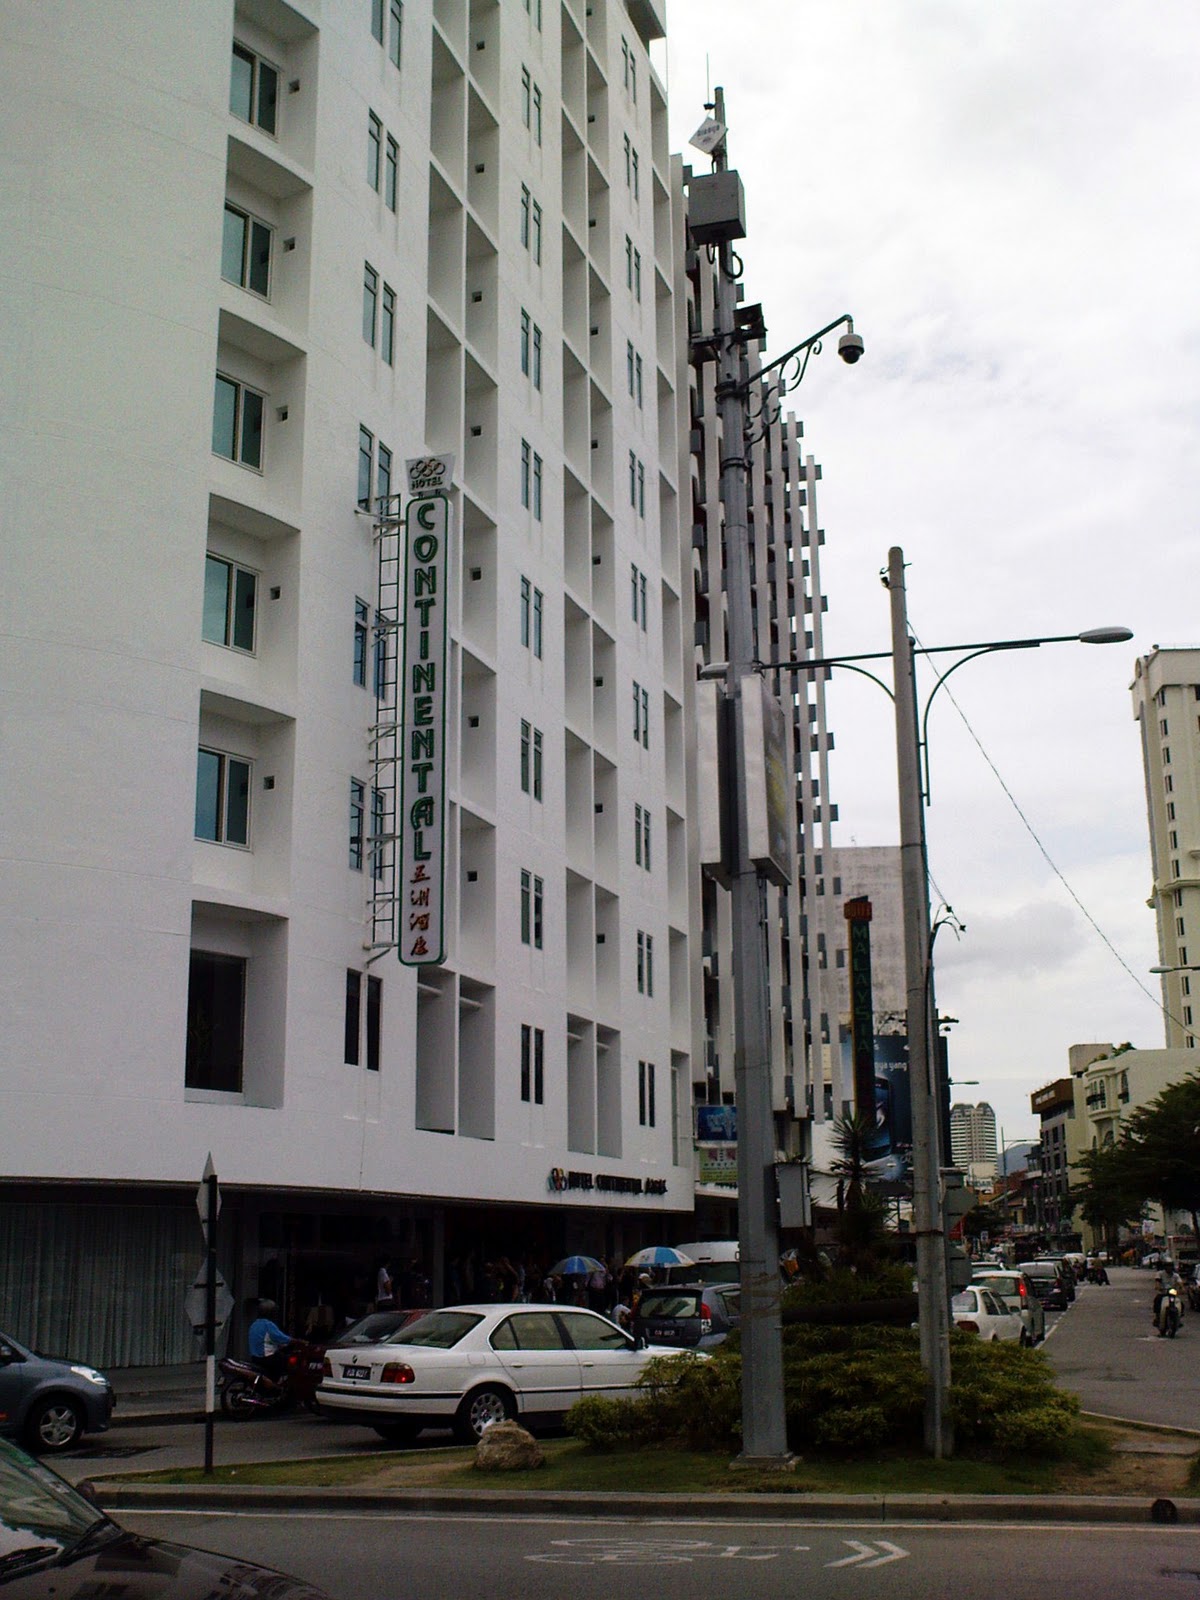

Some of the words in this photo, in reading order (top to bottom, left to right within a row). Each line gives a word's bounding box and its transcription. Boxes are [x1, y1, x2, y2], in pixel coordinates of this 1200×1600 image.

[411, 476, 443, 490] HOTEL
[410, 502, 438, 861] CONTINENTAL
[852, 925, 870, 1052] MALAYSIA
